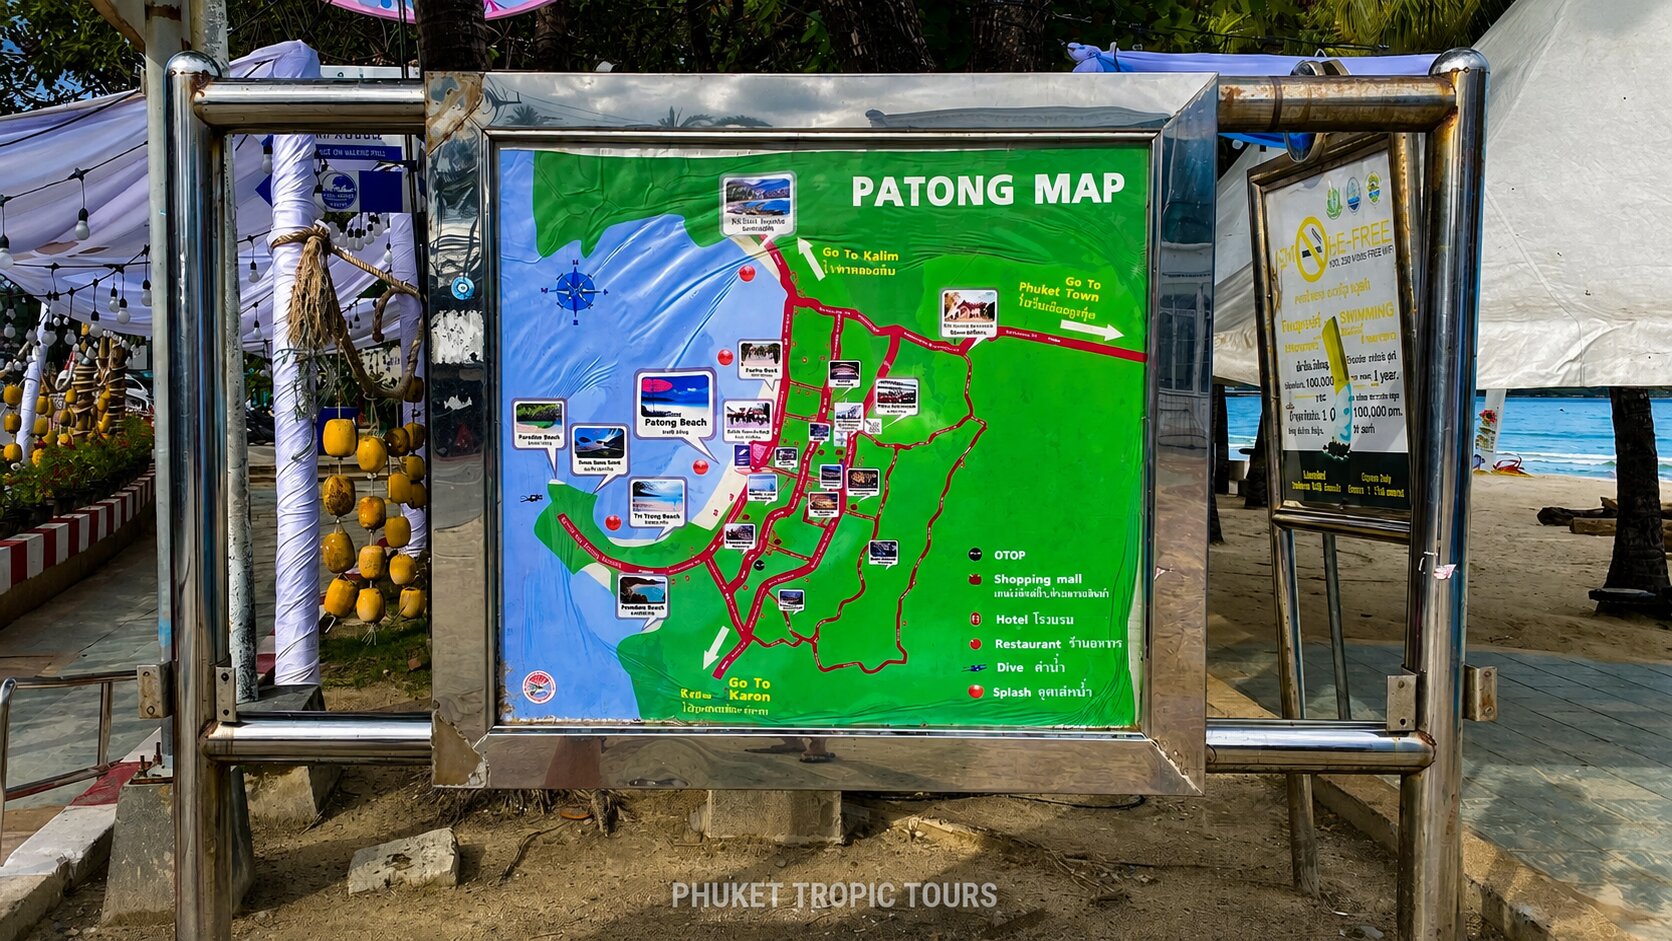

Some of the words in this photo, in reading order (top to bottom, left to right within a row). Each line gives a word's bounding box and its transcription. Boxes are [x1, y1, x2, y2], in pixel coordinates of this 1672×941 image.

[852, 174, 1014, 207] PATONG
[1034, 173, 1125, 205] MAP
[823, 247, 839, 257] Go
[844, 249, 858, 260] To
[864, 250, 899, 261] Kalim
[1065, 277, 1081, 287] Go
[1088, 279, 1101, 290] To
[1019, 282, 1060, 296] Phuket
[1066, 288, 1099, 302] Town
[1340, 301, 1394, 325] SWIMMING
[1354, 405, 1387, 418] 100,000
[645, 418, 677, 428] Patong
[680, 418, 707, 427] Beach
[994, 550, 1026, 560] OTOP
[994, 574, 1051, 586] Shopping
[1057, 573, 1082, 584] mall
[996, 614, 1028, 625] Hotel
[995, 639, 1061, 649] Restaurant
[997, 662, 1024, 672] Dive
[729, 677, 748, 688] Go
[754, 677, 770, 689] To
[729, 689, 770, 702] Karon
[993, 687, 1032, 699] Splash
